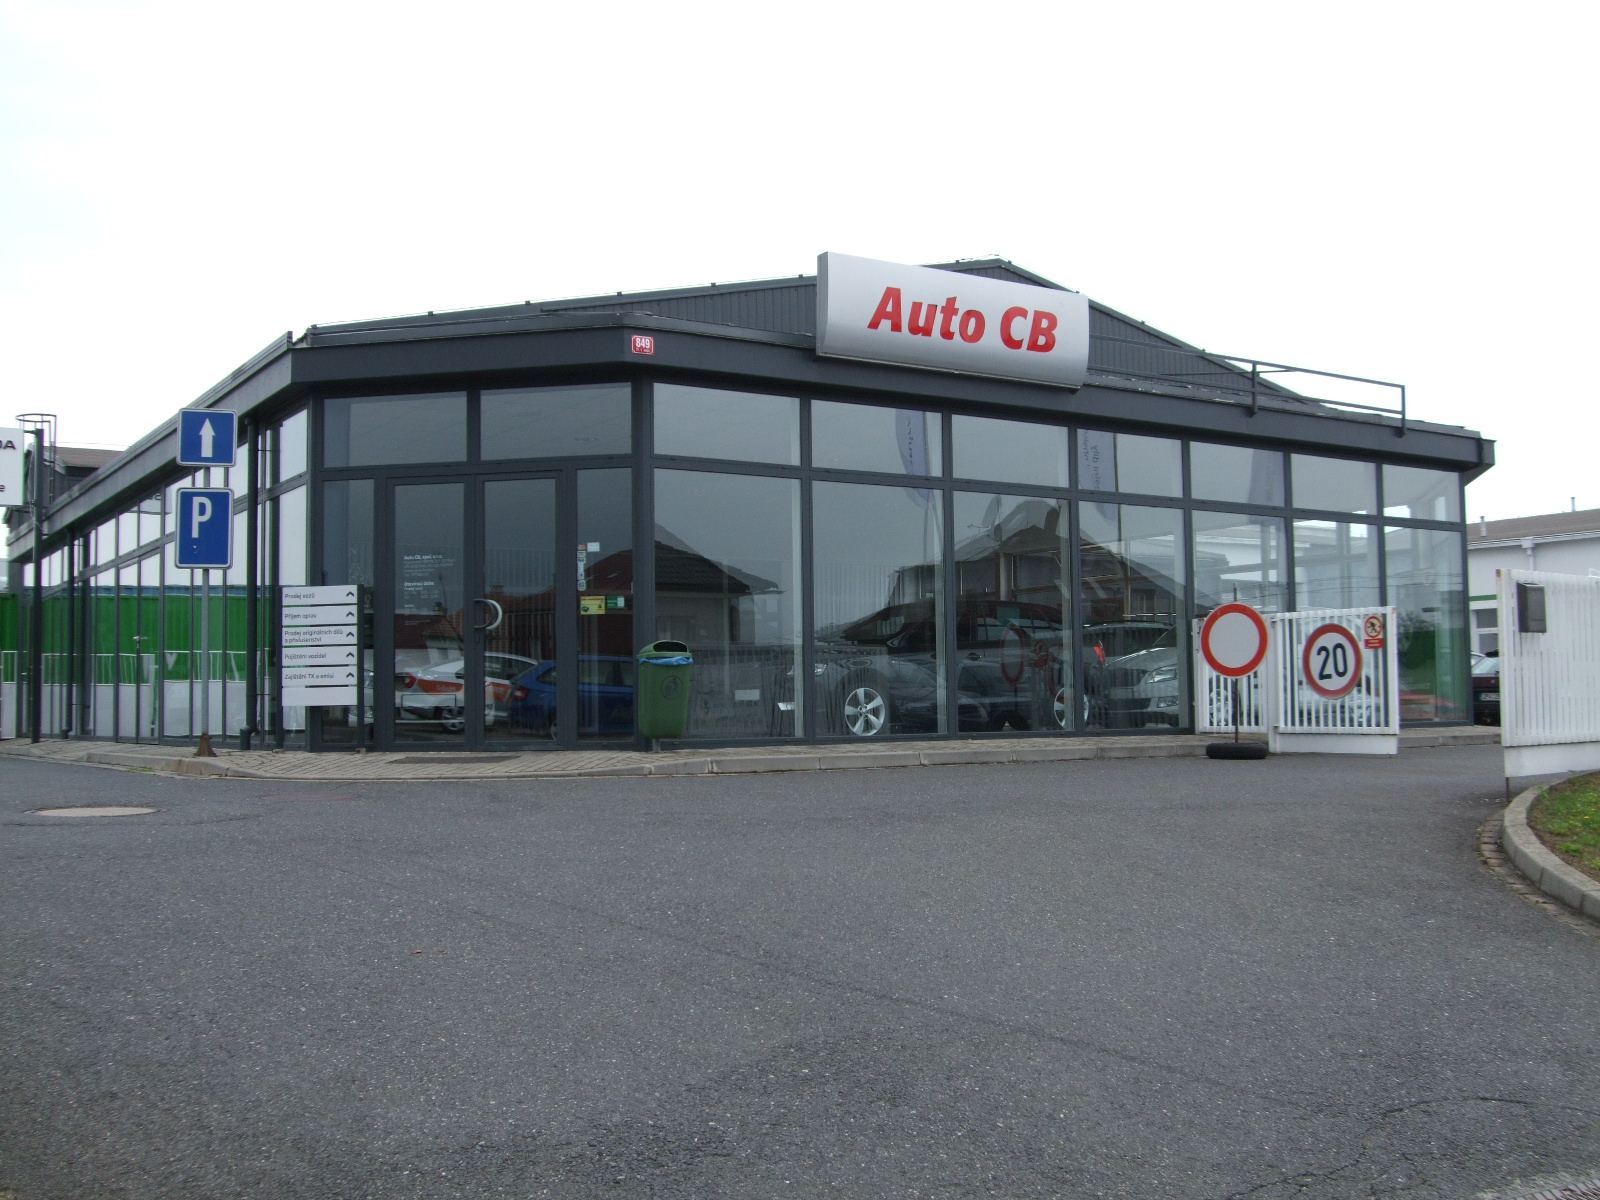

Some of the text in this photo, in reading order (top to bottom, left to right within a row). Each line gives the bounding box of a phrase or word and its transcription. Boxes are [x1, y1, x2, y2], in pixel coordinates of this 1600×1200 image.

[867, 286, 1057, 352] Auto CB
[635, 337, 650, 348] 849
[192, 496, 212, 538] P
[1317, 643, 1348, 680] 20
